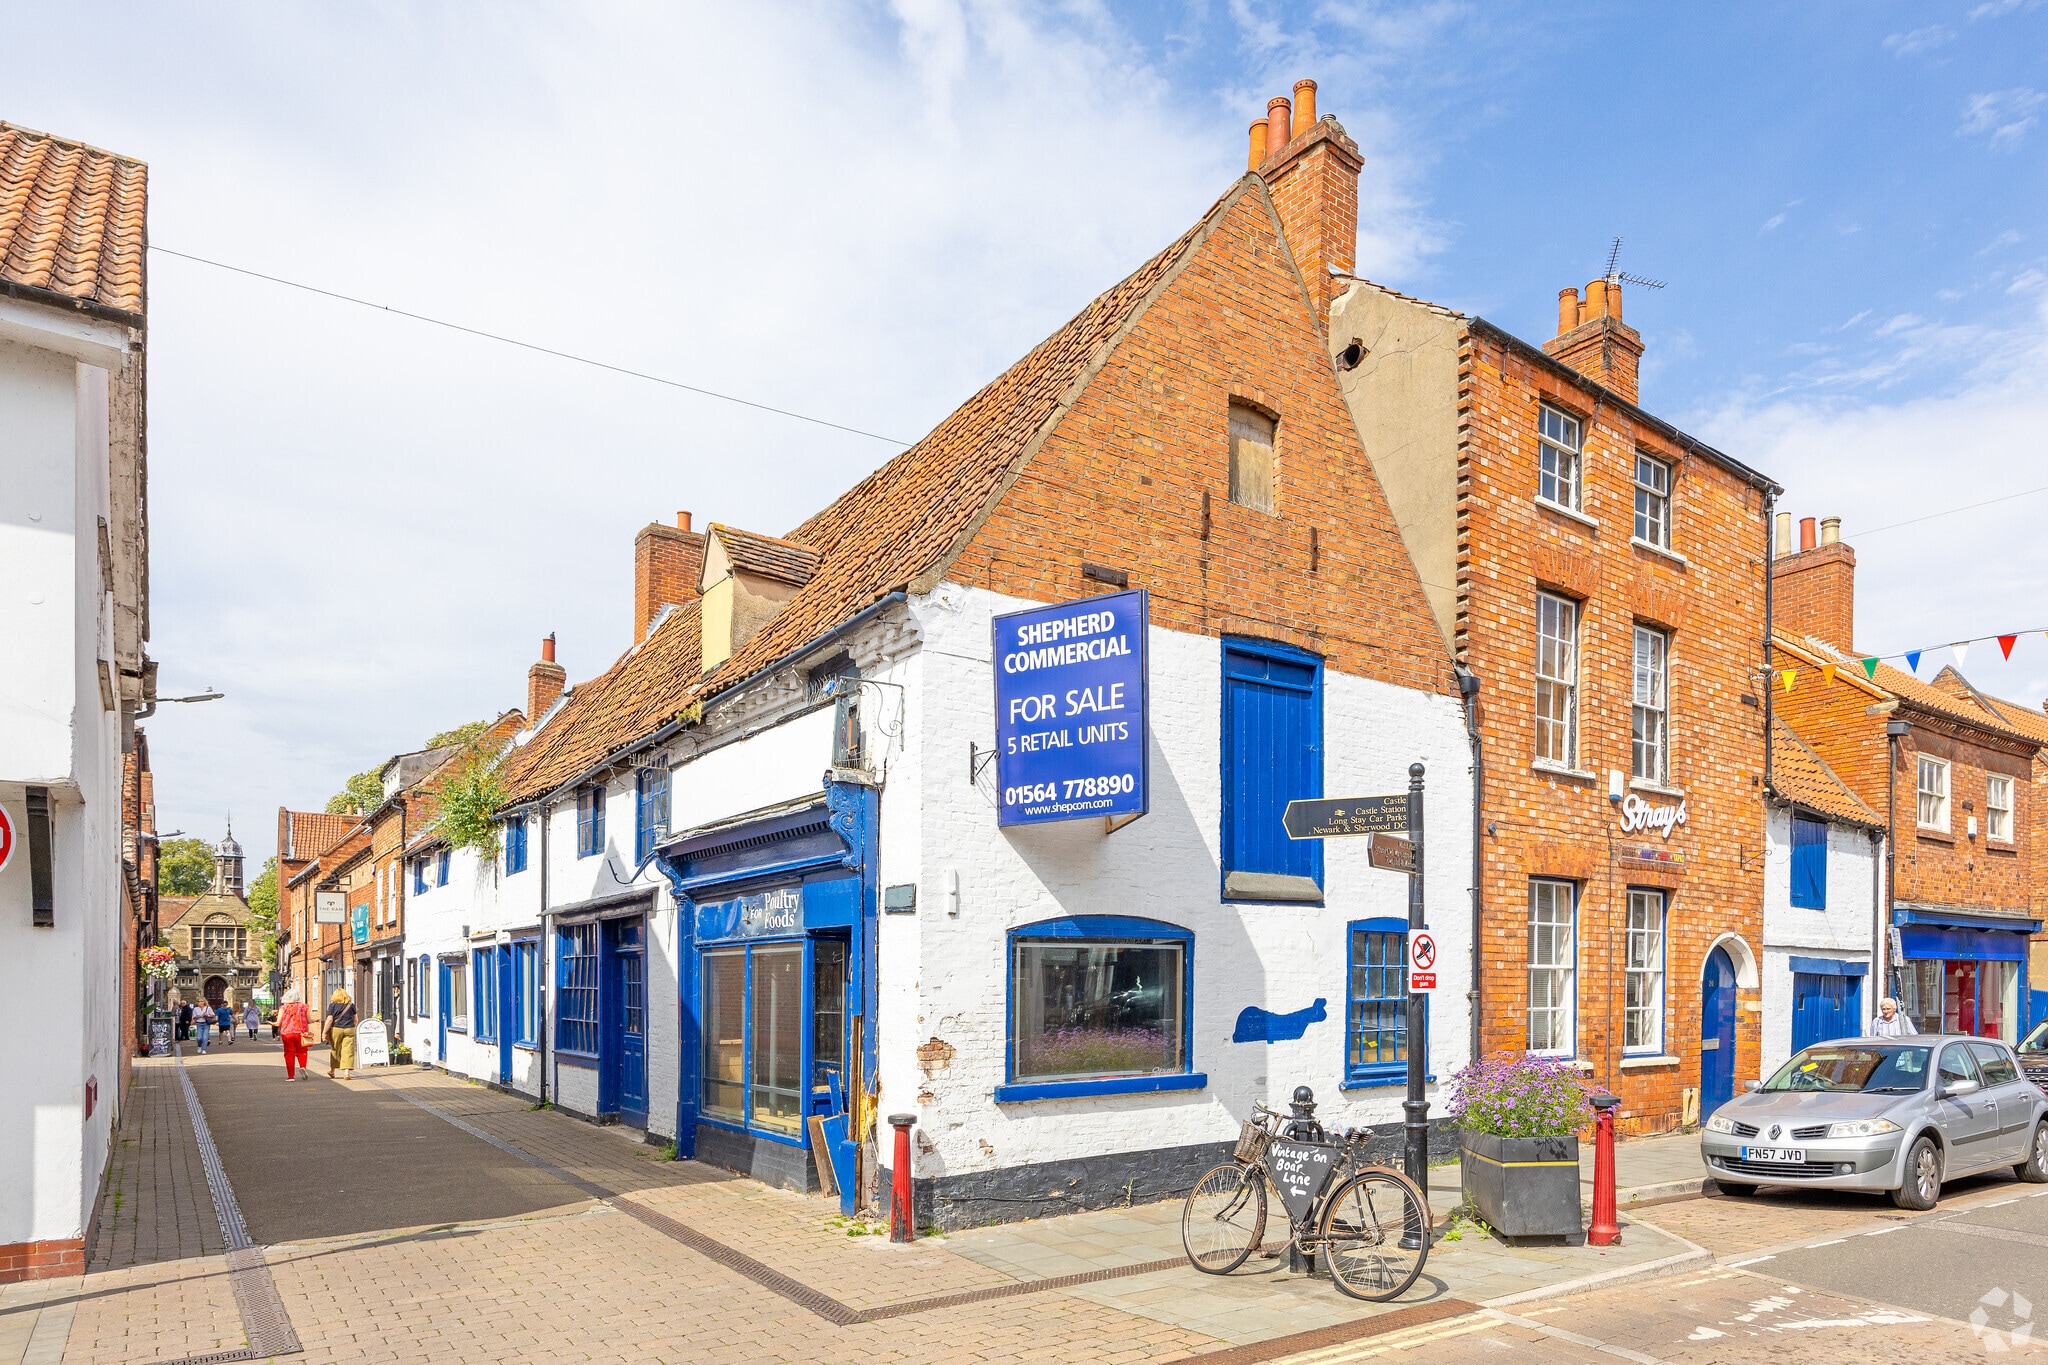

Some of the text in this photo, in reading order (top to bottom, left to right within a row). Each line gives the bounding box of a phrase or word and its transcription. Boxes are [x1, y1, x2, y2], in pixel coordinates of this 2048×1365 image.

[1018, 611, 1115, 647] SHEPHERD
[1004, 635, 1131, 673] COMMERCIAL
[1010, 682, 1125, 724] FOR SALE
[1007, 722, 1128, 755] 5 RETAIL UNITS
[1005, 773, 1134, 806] 01564 778890
[1025, 798, 1113, 815] www.shepcom.com
[1384, 797, 1406, 805] Castle
[1355, 807, 1378, 815] Castle
[1620, 794, 1686, 838] Strays
[1313, 826, 1340, 834] Newark
[1343, 825, 1351, 833] &
[1354, 822, 1391, 831] Sherwood
[1328, 818, 1348, 827] Long
[1350, 816, 1366, 825] Stay
[764, 889, 800, 914] Poultry
[750, 908, 763, 919] FOR
[764, 909, 795, 929] Foods
[364, 1047, 384, 1056] Open
[1271, 1142, 1327, 1164] Vintage on
[1748, 1149, 1802, 1161] FN57 JVD
[1276, 1158, 1303, 1173] Boar
[1283, 1171, 1311, 1186] Lane
